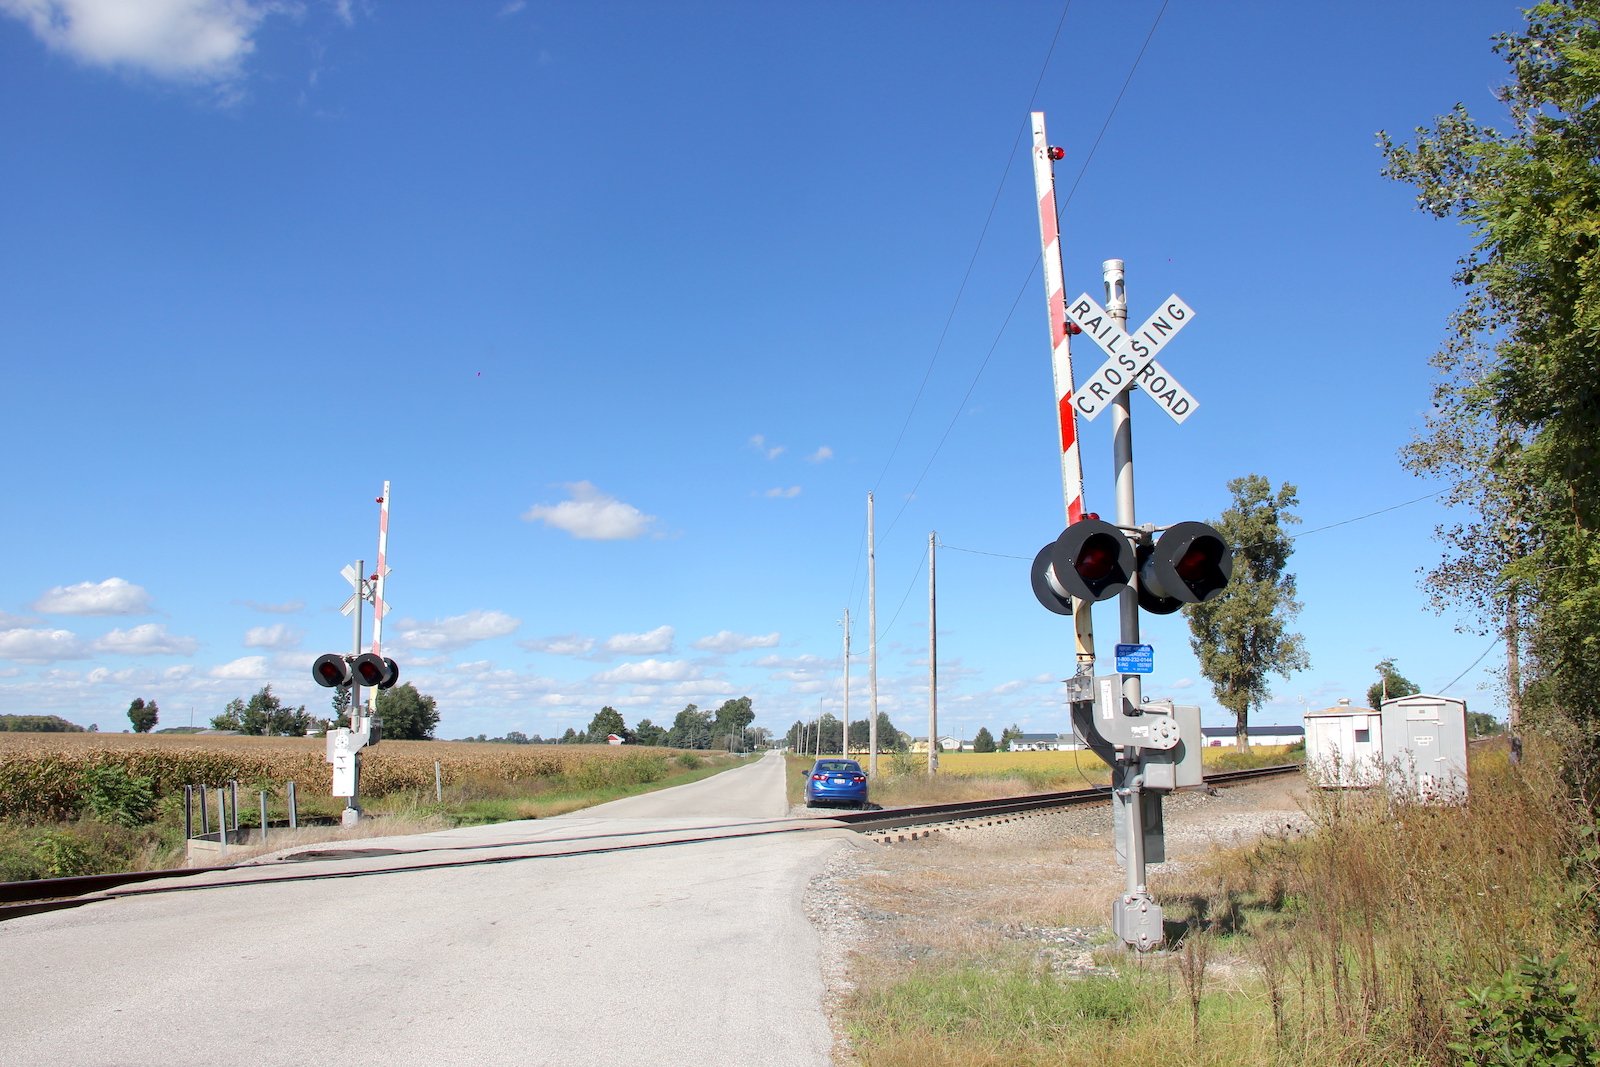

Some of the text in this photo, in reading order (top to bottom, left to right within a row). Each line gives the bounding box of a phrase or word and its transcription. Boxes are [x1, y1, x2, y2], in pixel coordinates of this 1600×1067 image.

[1072, 300, 1189, 416] RAIL ROAD
[1077, 304, 1185, 414] CROSSING
